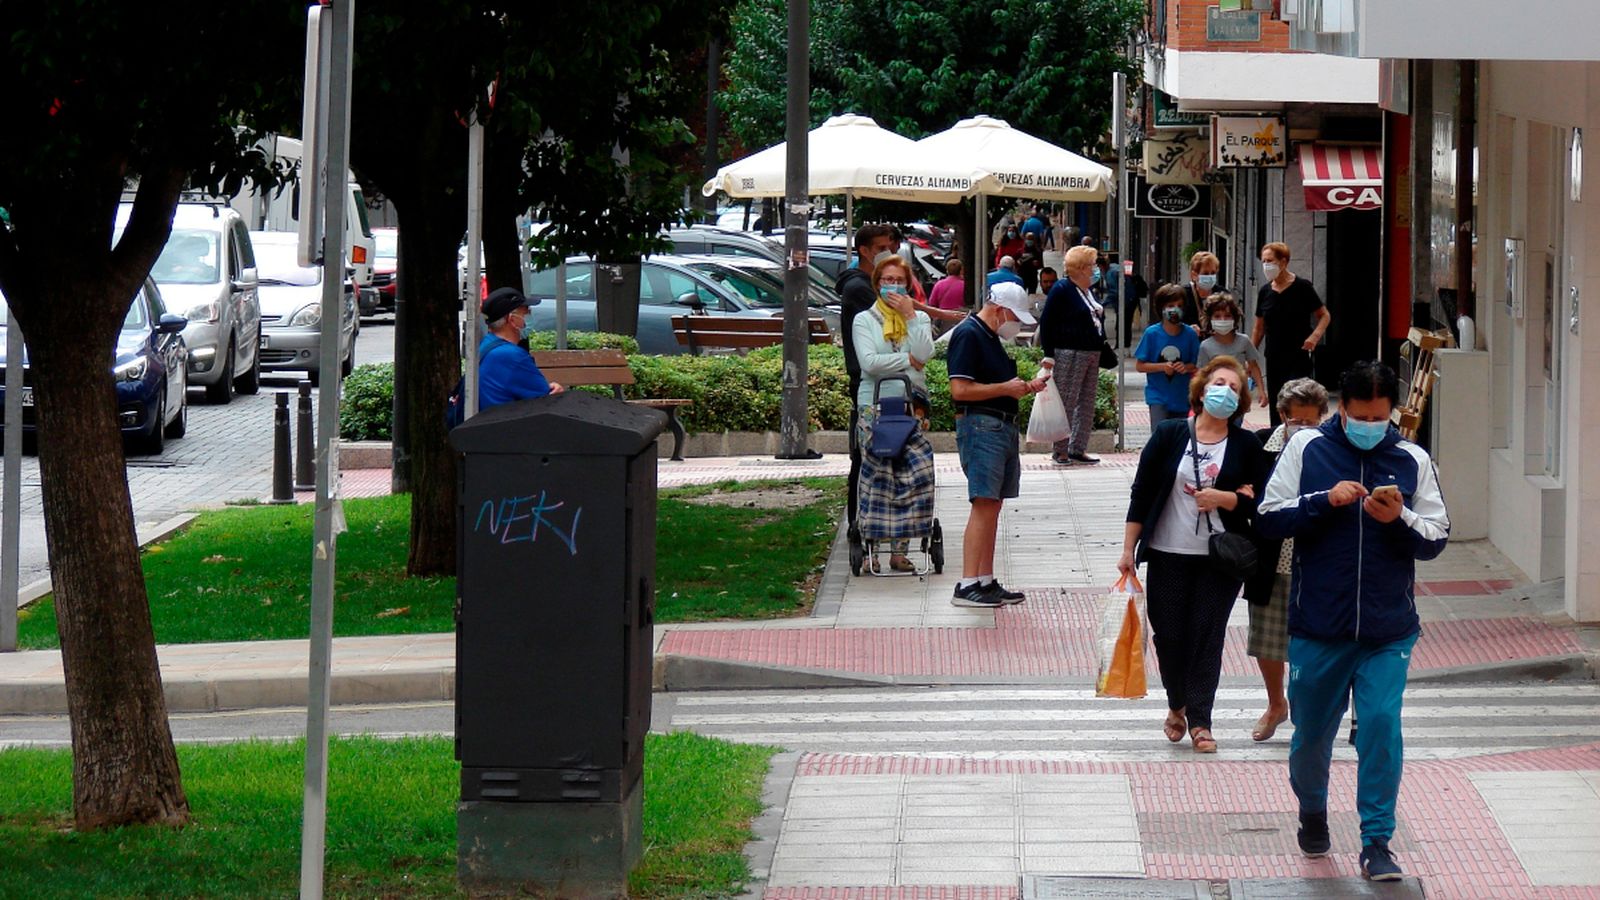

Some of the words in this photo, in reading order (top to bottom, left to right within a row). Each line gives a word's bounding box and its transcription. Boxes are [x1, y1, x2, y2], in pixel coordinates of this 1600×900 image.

[1226, 136, 1239, 146] EL
[1241, 136, 1280, 146] PARQUE
[875, 174, 924, 187] CERVEZAS
[927, 177, 971, 189] ALHAMB
[1036, 175, 1090, 189] ALHAMBRA
